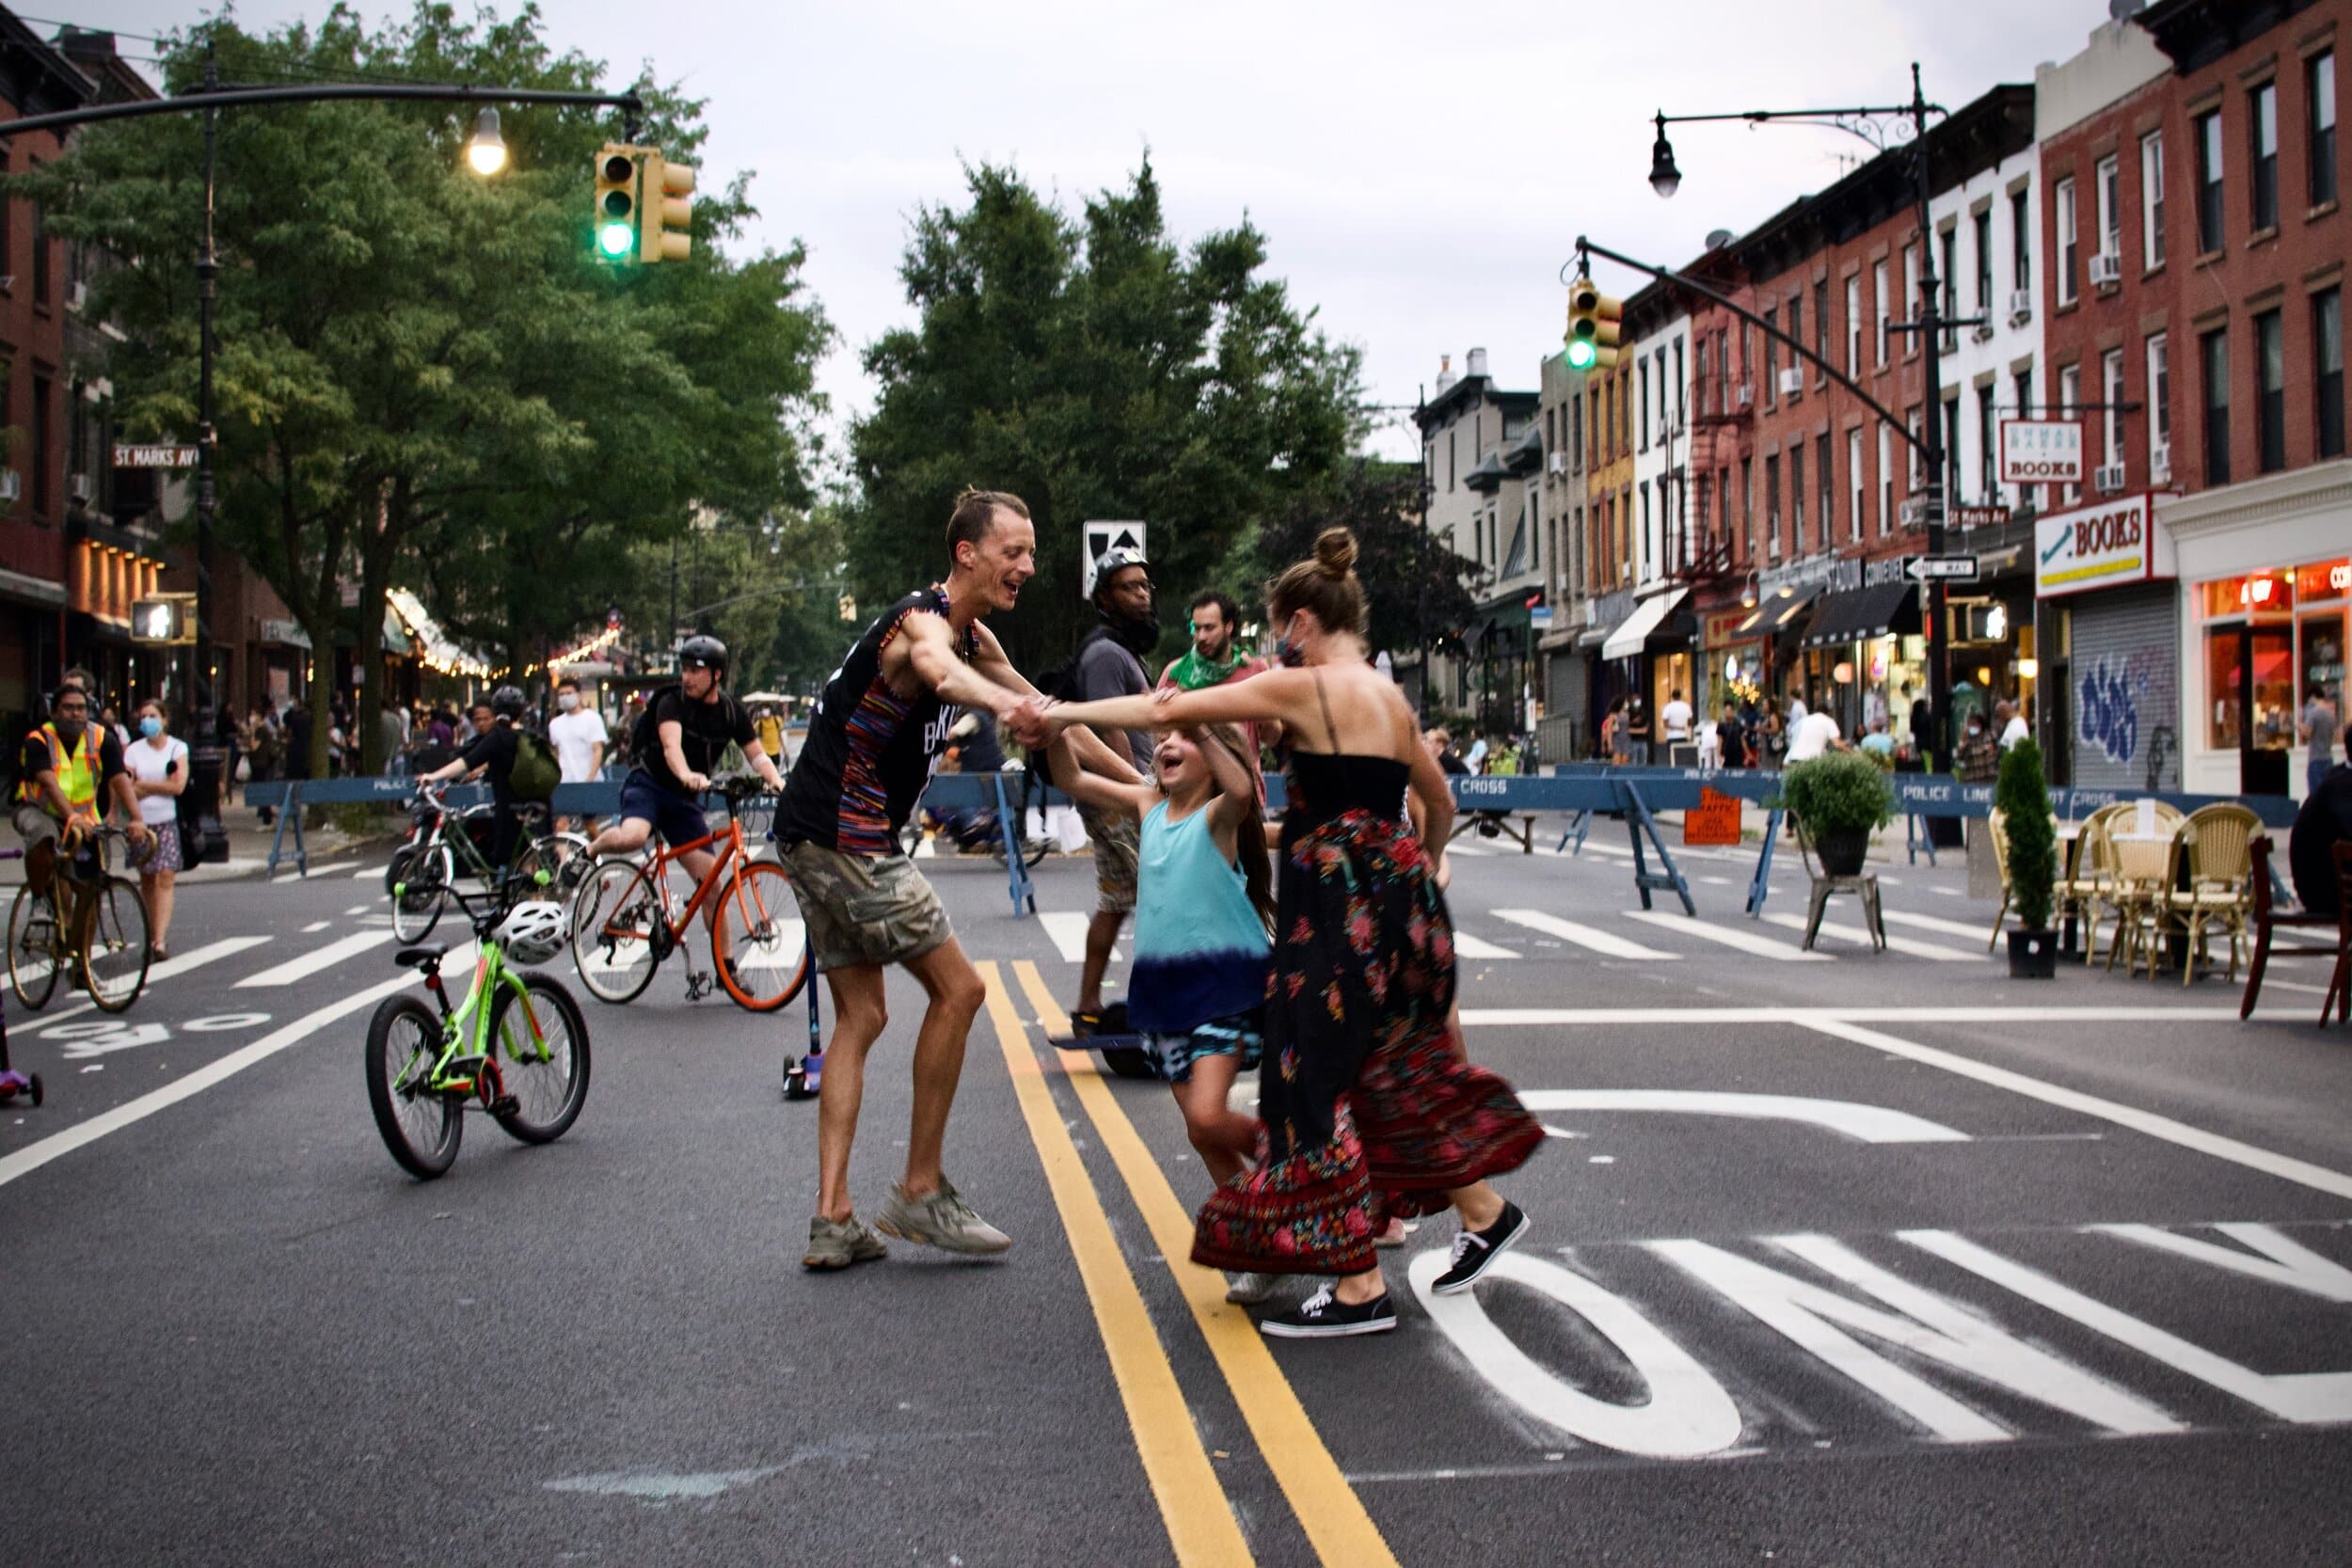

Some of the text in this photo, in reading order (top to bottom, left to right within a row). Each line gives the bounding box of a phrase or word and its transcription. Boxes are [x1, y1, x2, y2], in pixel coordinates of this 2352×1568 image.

[134, 449, 174, 467] MARKS
[2010, 462, 2077, 476] BOOKS
[2074, 508, 2140, 558] BOOKS
[1914, 564, 1968, 575] ONE WAY
[1460, 779, 1507, 794] CROSS
[1903, 784, 1950, 800] POLICE
[1963, 787, 1993, 802] LINE
